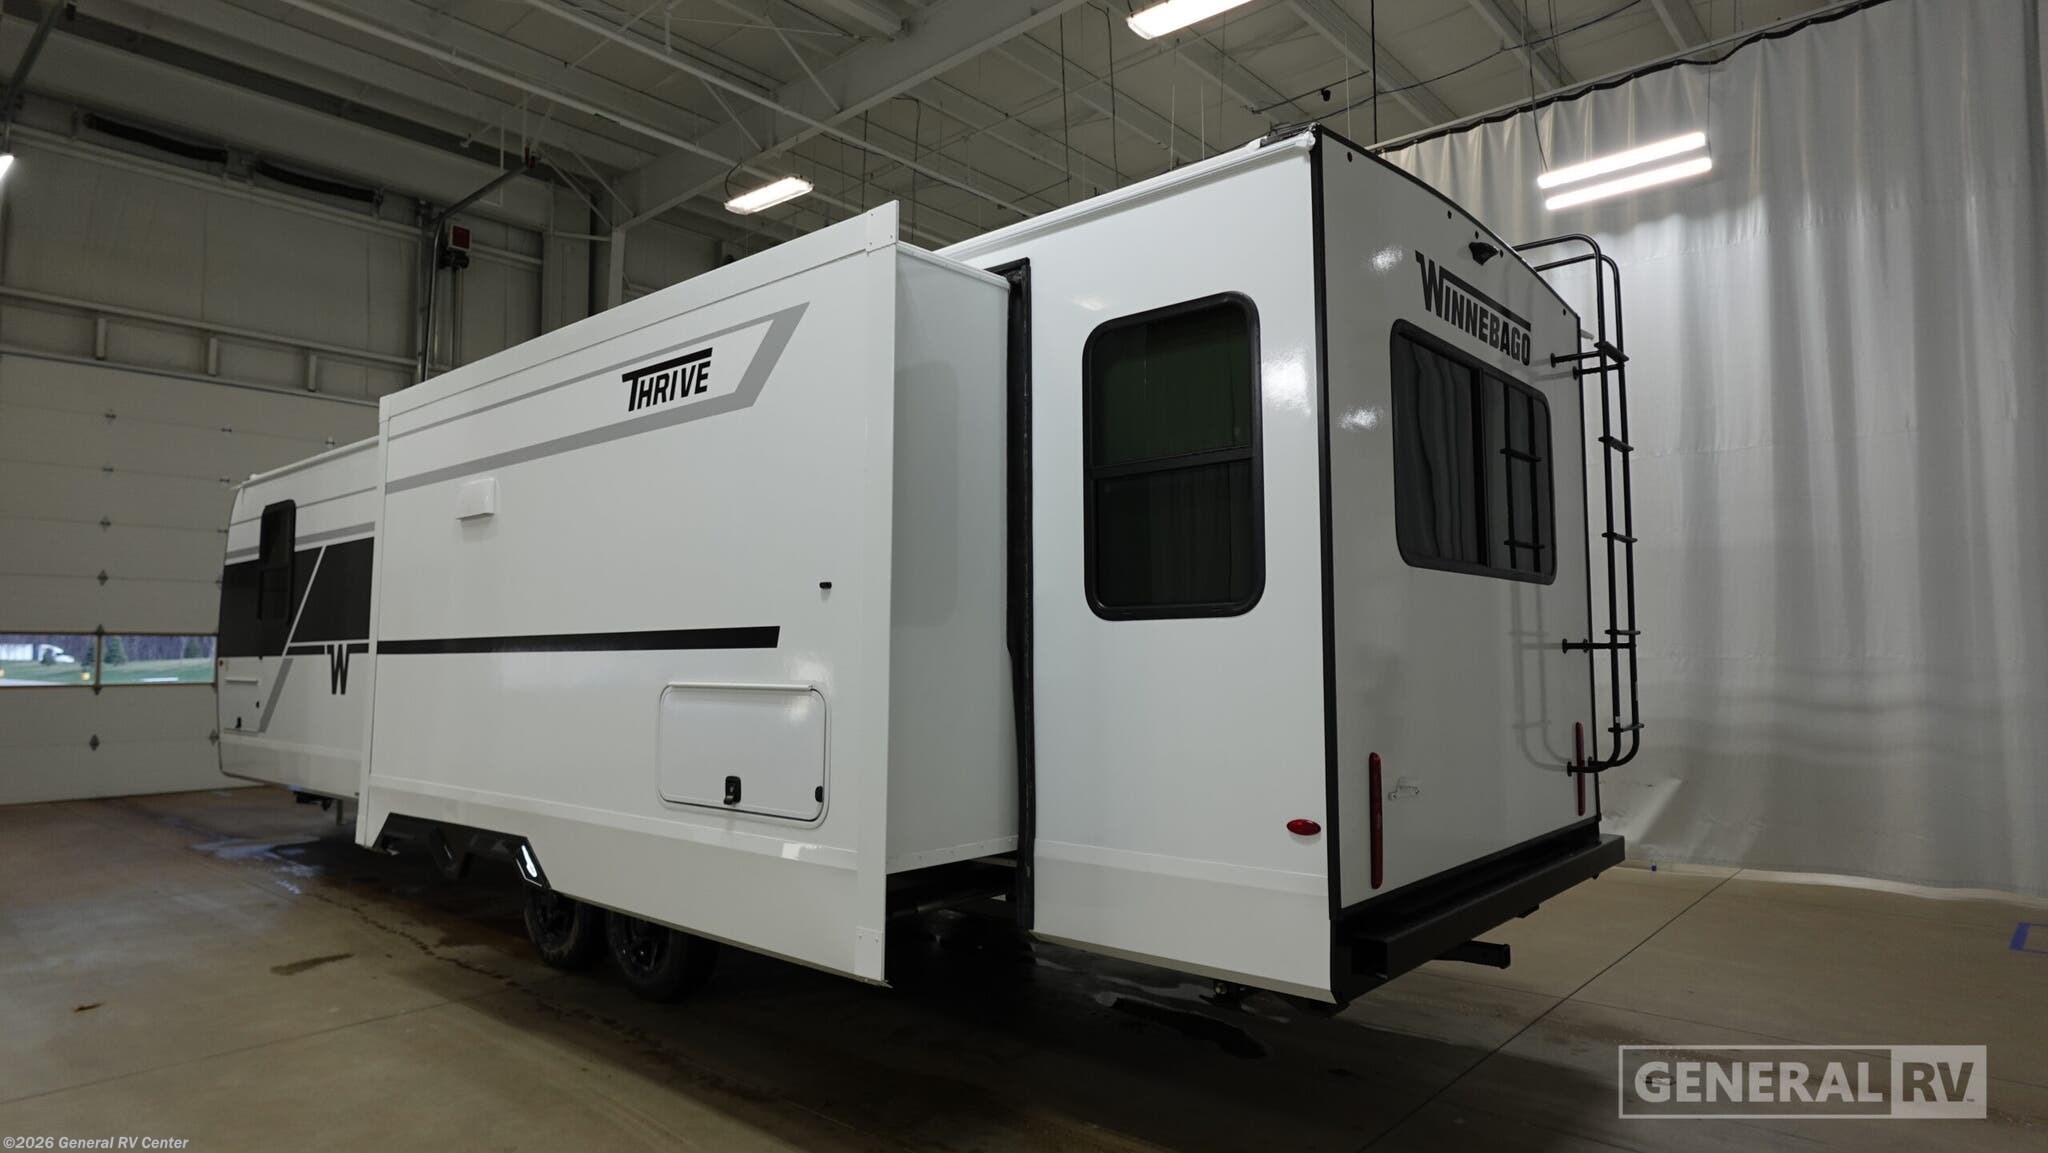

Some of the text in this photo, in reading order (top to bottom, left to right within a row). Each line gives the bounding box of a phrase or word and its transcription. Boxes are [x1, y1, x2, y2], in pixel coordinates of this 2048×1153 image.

[1415, 249, 1532, 367] WINNEBAGO
[622, 347, 713, 412] THRIVE
[327, 643, 350, 695] W
